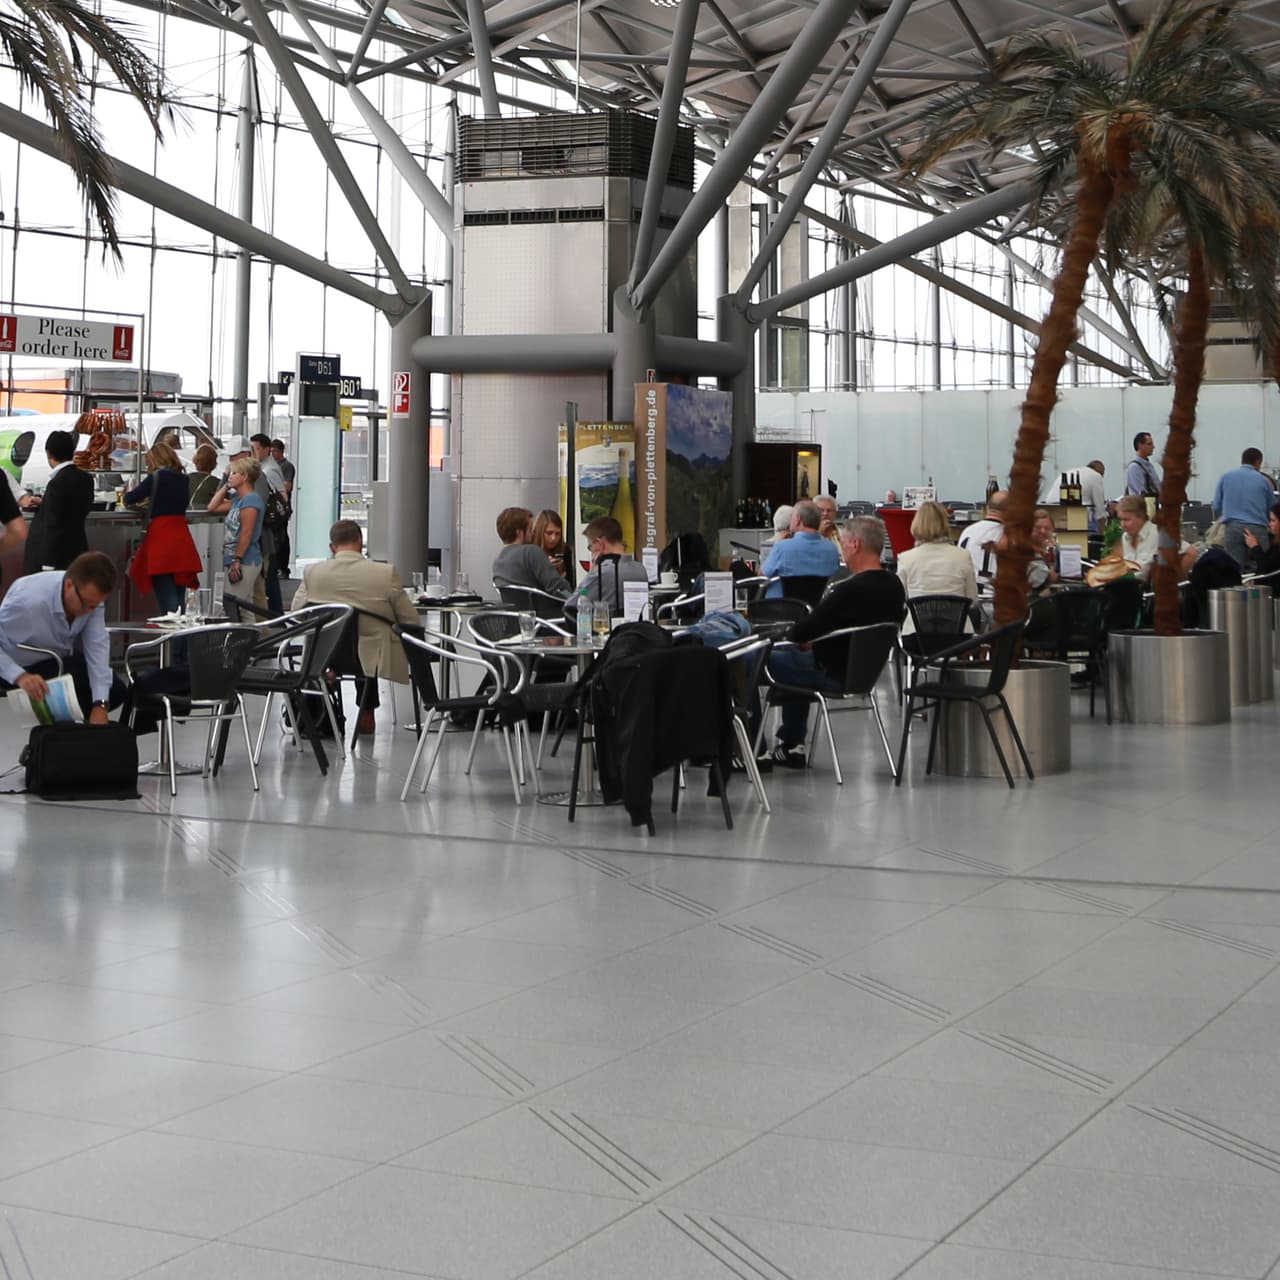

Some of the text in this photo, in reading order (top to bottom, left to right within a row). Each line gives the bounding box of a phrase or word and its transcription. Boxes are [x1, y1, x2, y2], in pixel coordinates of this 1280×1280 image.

[38, 318, 91, 338] Please
[22, 338, 69, 357] order
[73, 340, 108, 360] here
[317, 361, 333, 376] D61
[645, 389, 658, 549] hsgraf-von-plettenberg.de
